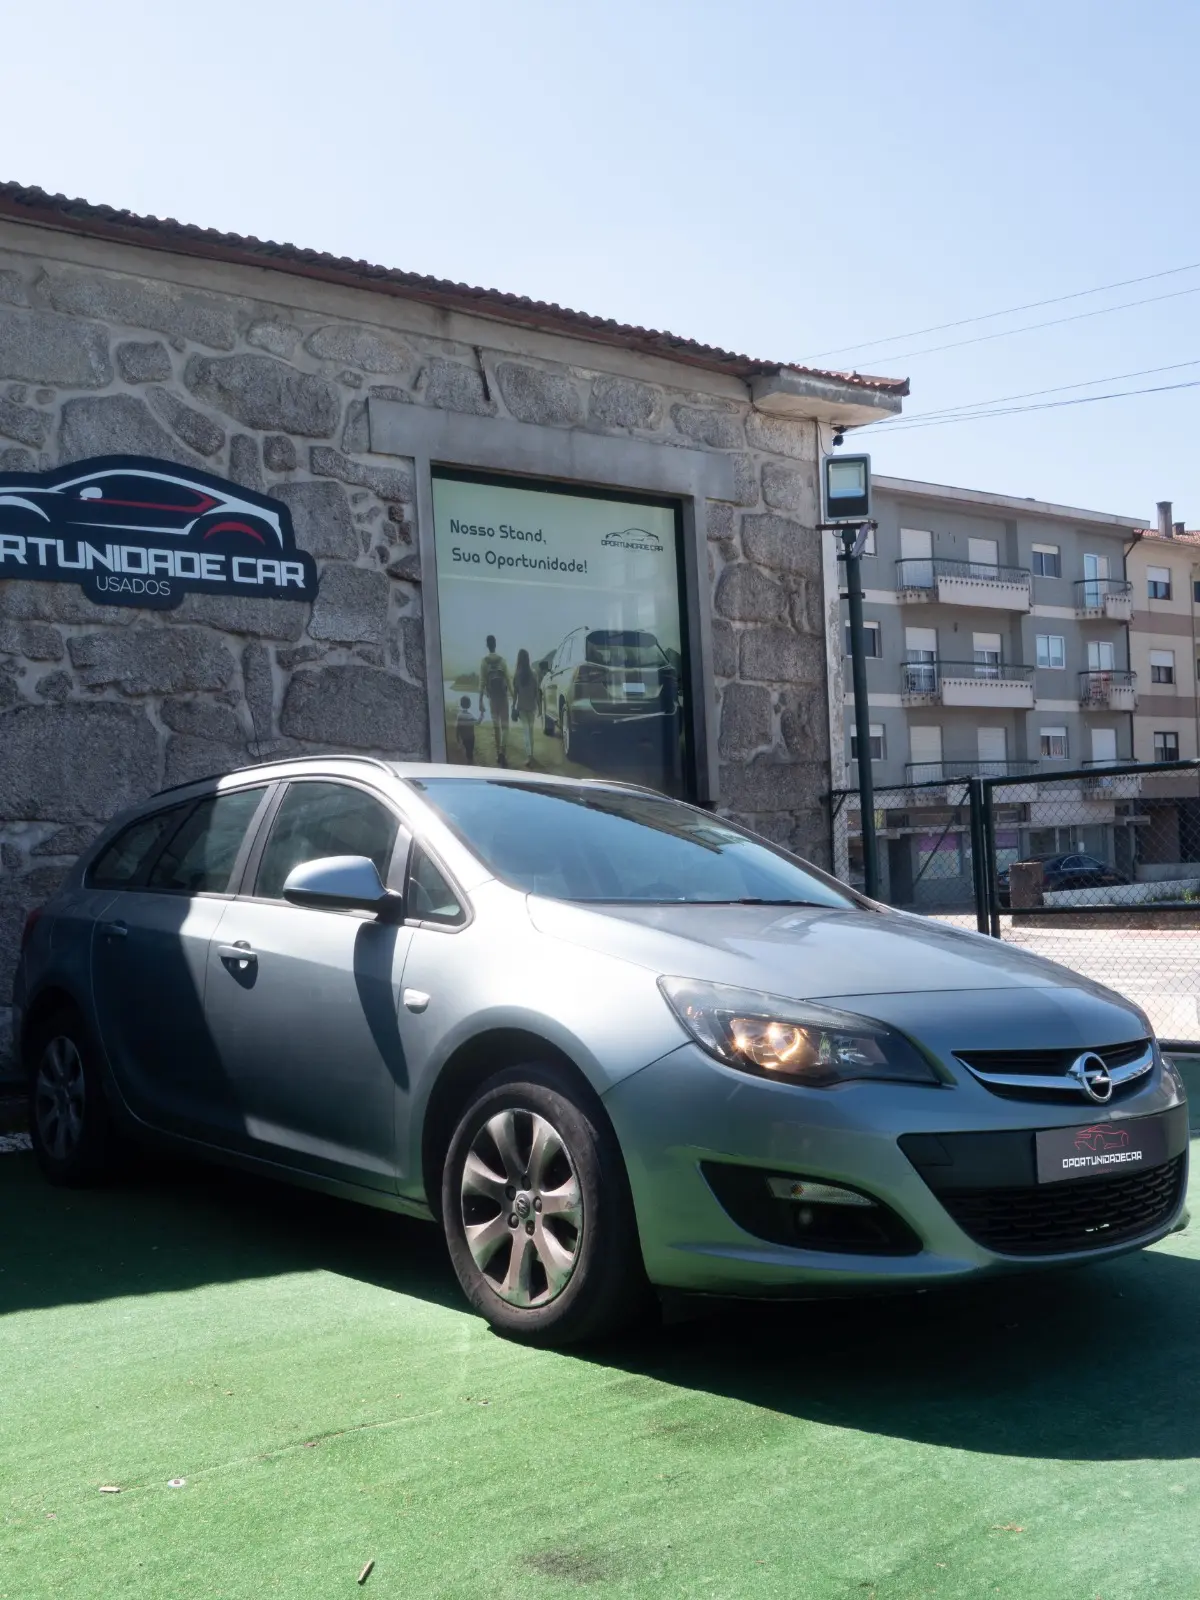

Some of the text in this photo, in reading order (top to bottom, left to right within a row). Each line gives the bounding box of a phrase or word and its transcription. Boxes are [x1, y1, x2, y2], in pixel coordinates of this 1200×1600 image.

[450, 519, 547, 544] Nosso Stand,
[601, 539, 650, 551] OPORTUNIDADE
[232, 556, 306, 588] CAR
[452, 547, 588, 574] Sua Oportunidade!
[96, 576, 171, 596] USADOS
